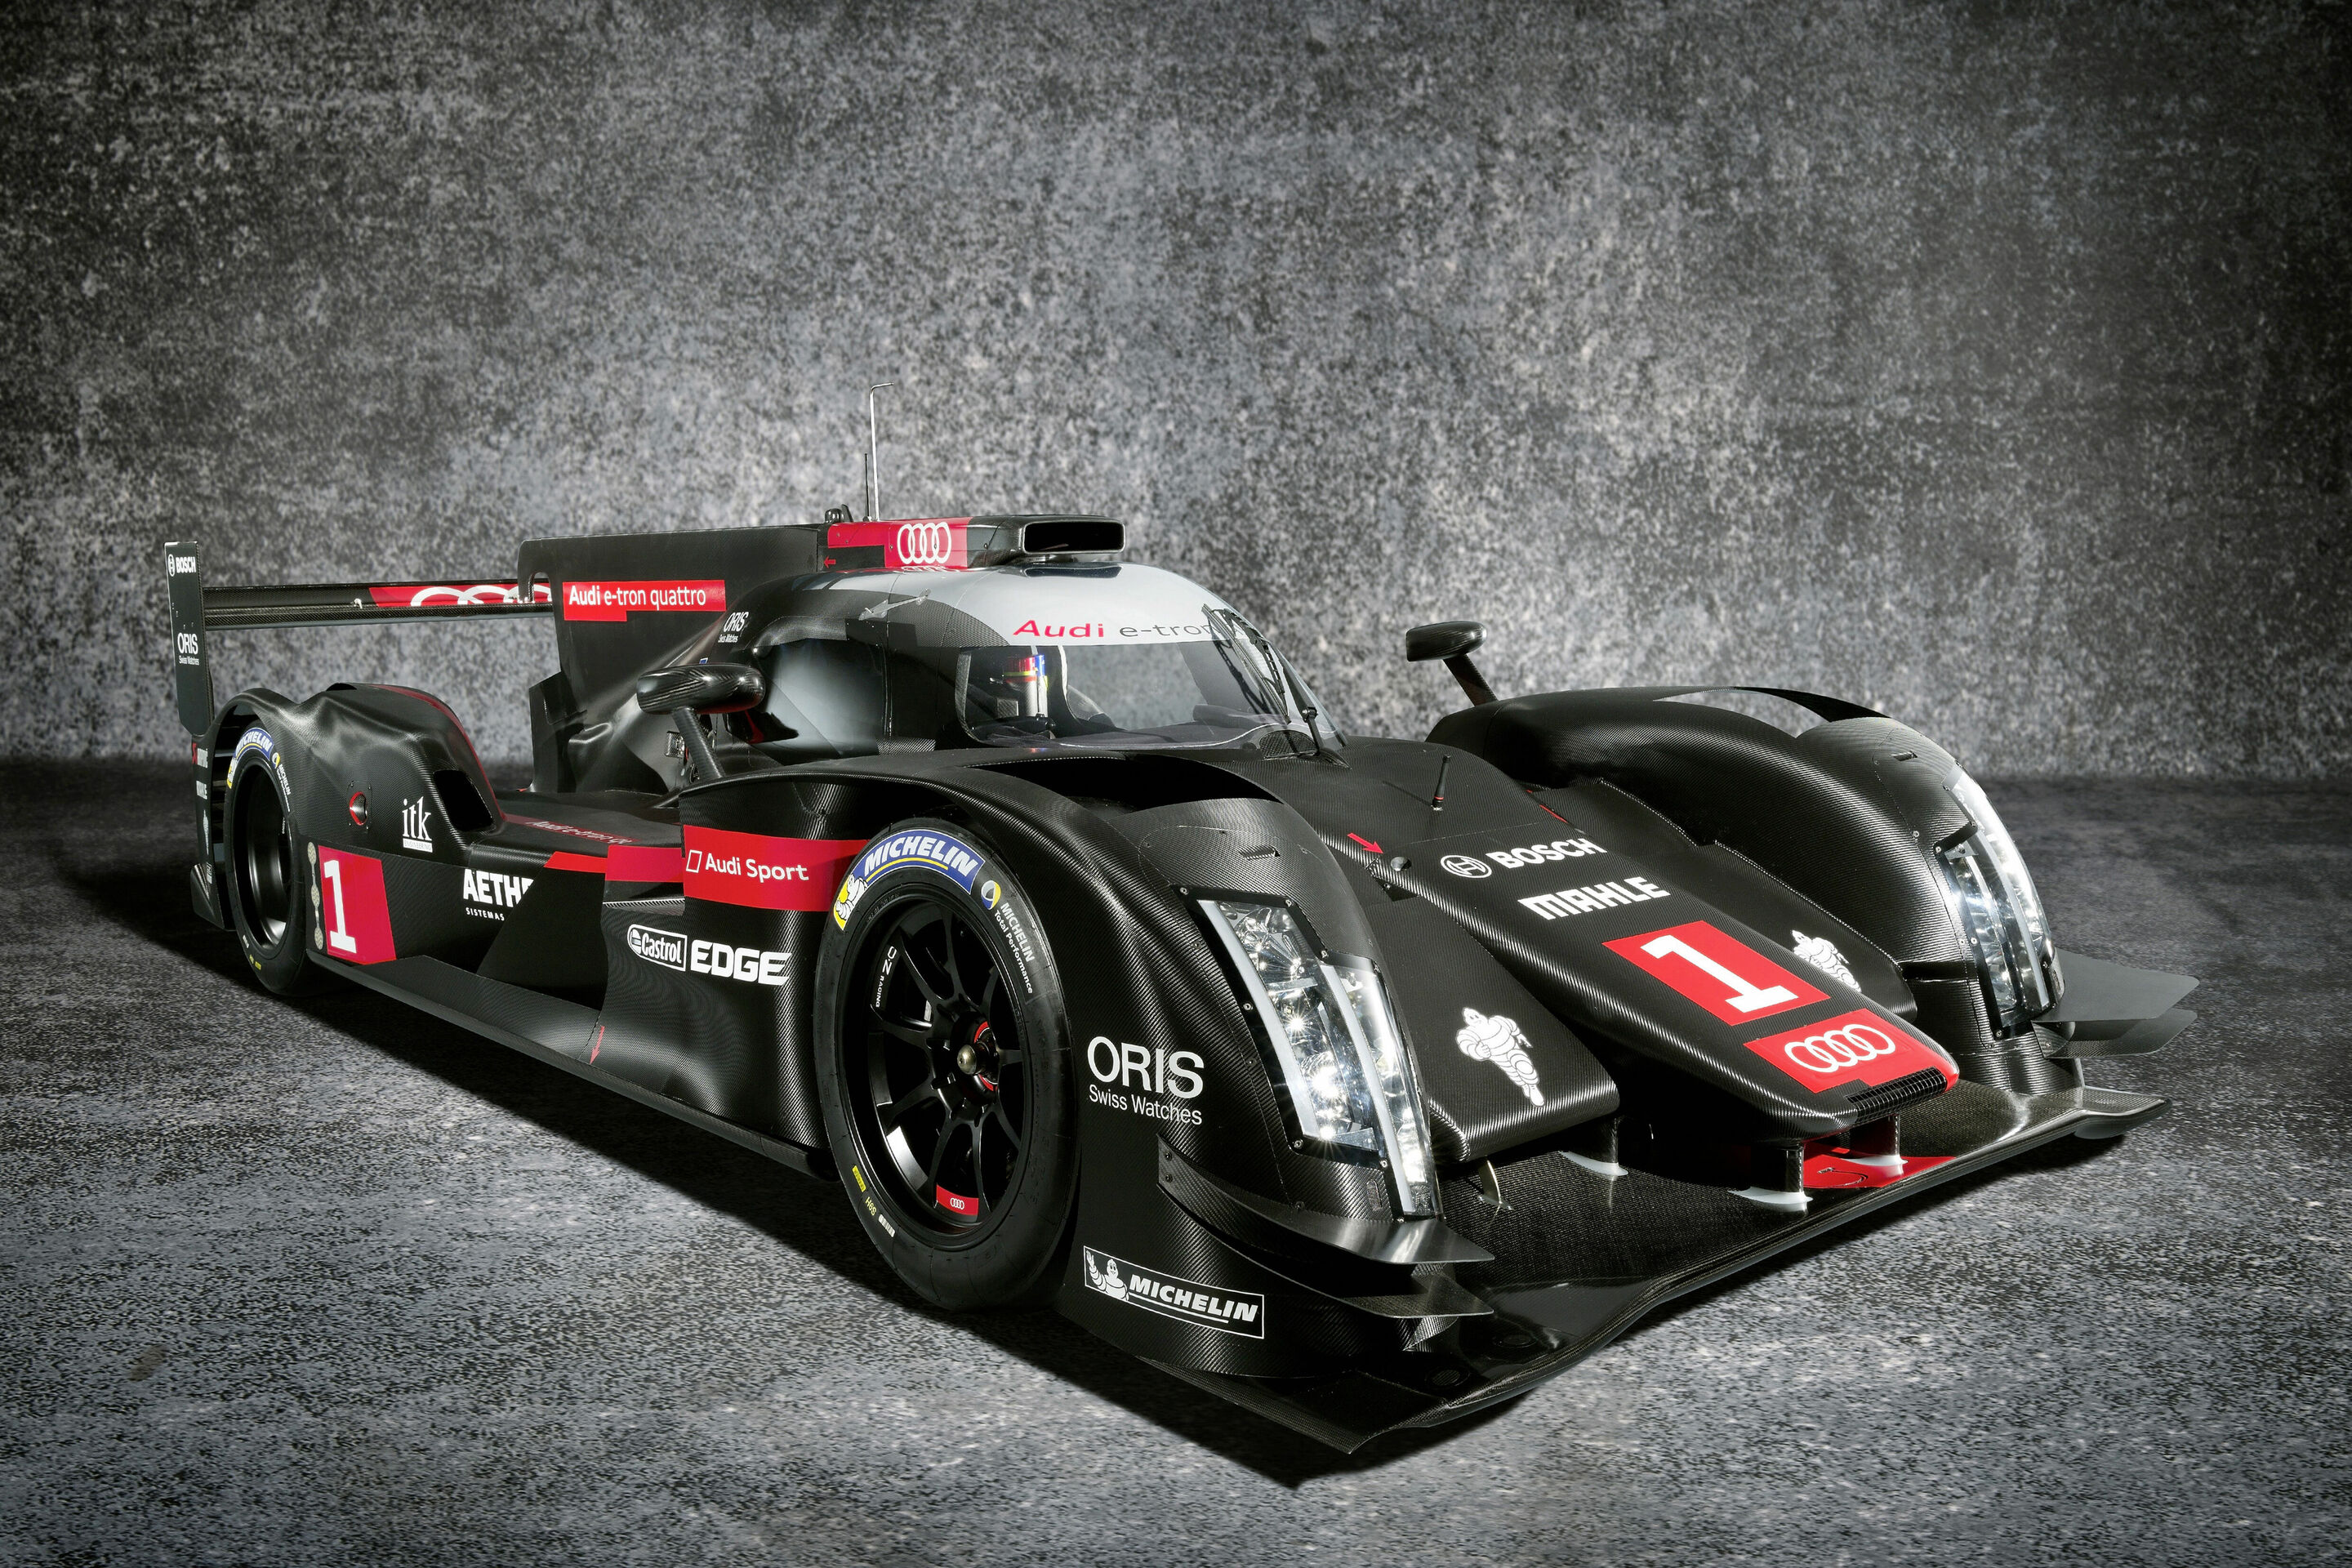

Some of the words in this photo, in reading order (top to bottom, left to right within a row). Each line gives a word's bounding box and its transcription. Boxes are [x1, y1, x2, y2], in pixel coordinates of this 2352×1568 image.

[176, 556, 197, 573] BOSCH
[569, 585, 600, 605] Audi
[604, 587, 647, 606] e-tron
[650, 586, 706, 611] quattro
[724, 611, 749, 633] ORIS
[1013, 620, 1104, 637] Audi
[177, 632, 198, 654] ORIS
[278, 764, 291, 796] MICHELIN
[402, 795, 433, 841] itk
[705, 853, 742, 875] Audi
[746, 858, 809, 884] Sport
[864, 835, 978, 877] MICHELIN
[1485, 838, 1608, 869] BOSCH
[323, 859, 357, 954] 1
[466, 906, 505, 921] SISTEMAS
[1517, 876, 1671, 920] MAHLE
[994, 910, 1008, 935] Total
[1006, 934, 1033, 995] Performance
[1000, 902, 1036, 963] MICHELIN
[640, 932, 682, 964] Castrol
[690, 939, 792, 986] EDGE
[1639, 934, 1799, 1013] 1
[875, 974, 885, 1009] RACING
[1087, 1036, 1205, 1098] ORIS
[1089, 1084, 1128, 1111] Swiss
[1131, 1094, 1203, 1125] Watches
[1129, 1274, 1258, 1323] MICHELIN
